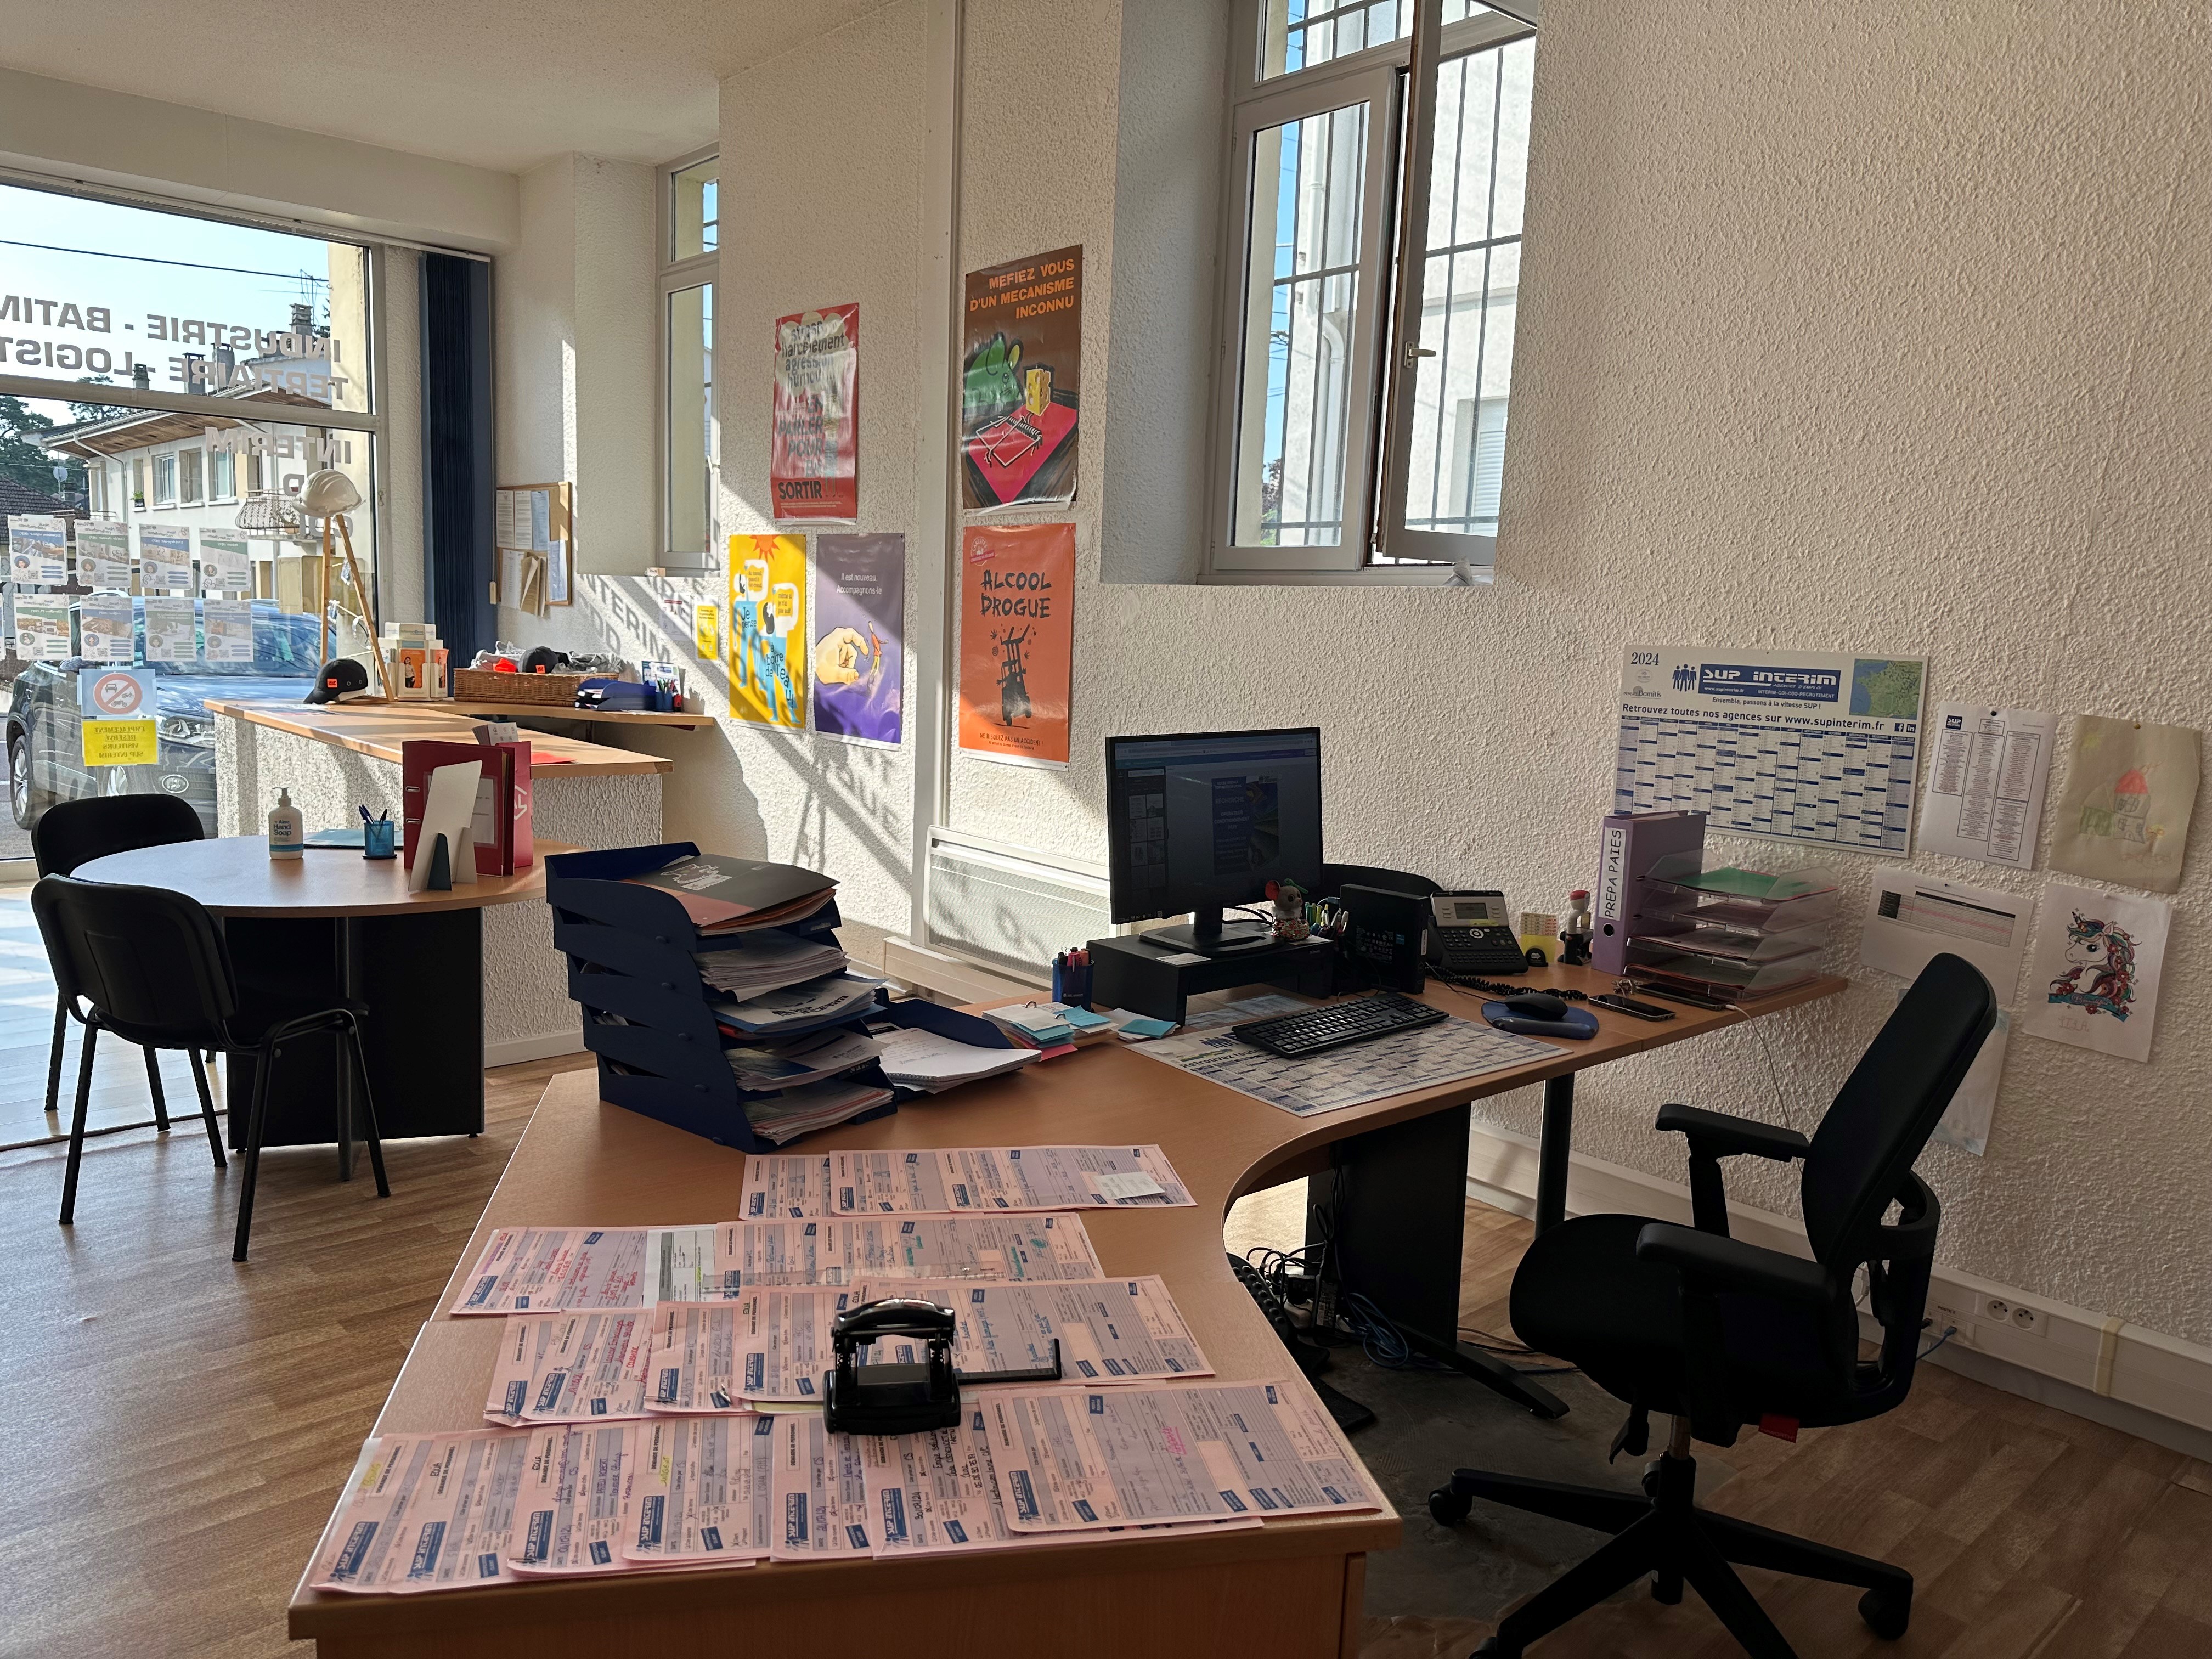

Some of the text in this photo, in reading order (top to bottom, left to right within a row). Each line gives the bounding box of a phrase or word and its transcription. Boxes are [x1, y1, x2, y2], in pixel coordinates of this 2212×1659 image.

[989, 258, 1075, 289] MEFIEZ VOUS
[970, 276, 1074, 311] D'UN MECANISME
[1016, 295, 1074, 319] INCONNU
[778, 416, 823, 436] PARLER
[788, 438, 823, 458] POUR
[778, 481, 823, 500] SORTIR
[840, 572, 845, 582] Il
[980, 569, 1052, 591] ALCOOL
[836, 585, 883, 596] Accompagnons-le
[741, 606, 751, 621] Je
[980, 592, 1052, 619] DROGUE
[741, 618, 757, 632] pense
[766, 651, 784, 666] boire
[1630, 652, 1660, 665] 2024
[765, 666, 774, 678] de
[1702, 669, 1741, 680] SUP
[1712, 697, 1742, 705] Ensemble,
[1622, 703, 1884, 732] Retrouvez toutes nos agences sur www.supinterim.fr
[1604, 829, 1622, 918] PREPA PAIES
[1180, 1055, 1233, 1069] Retrouvez
